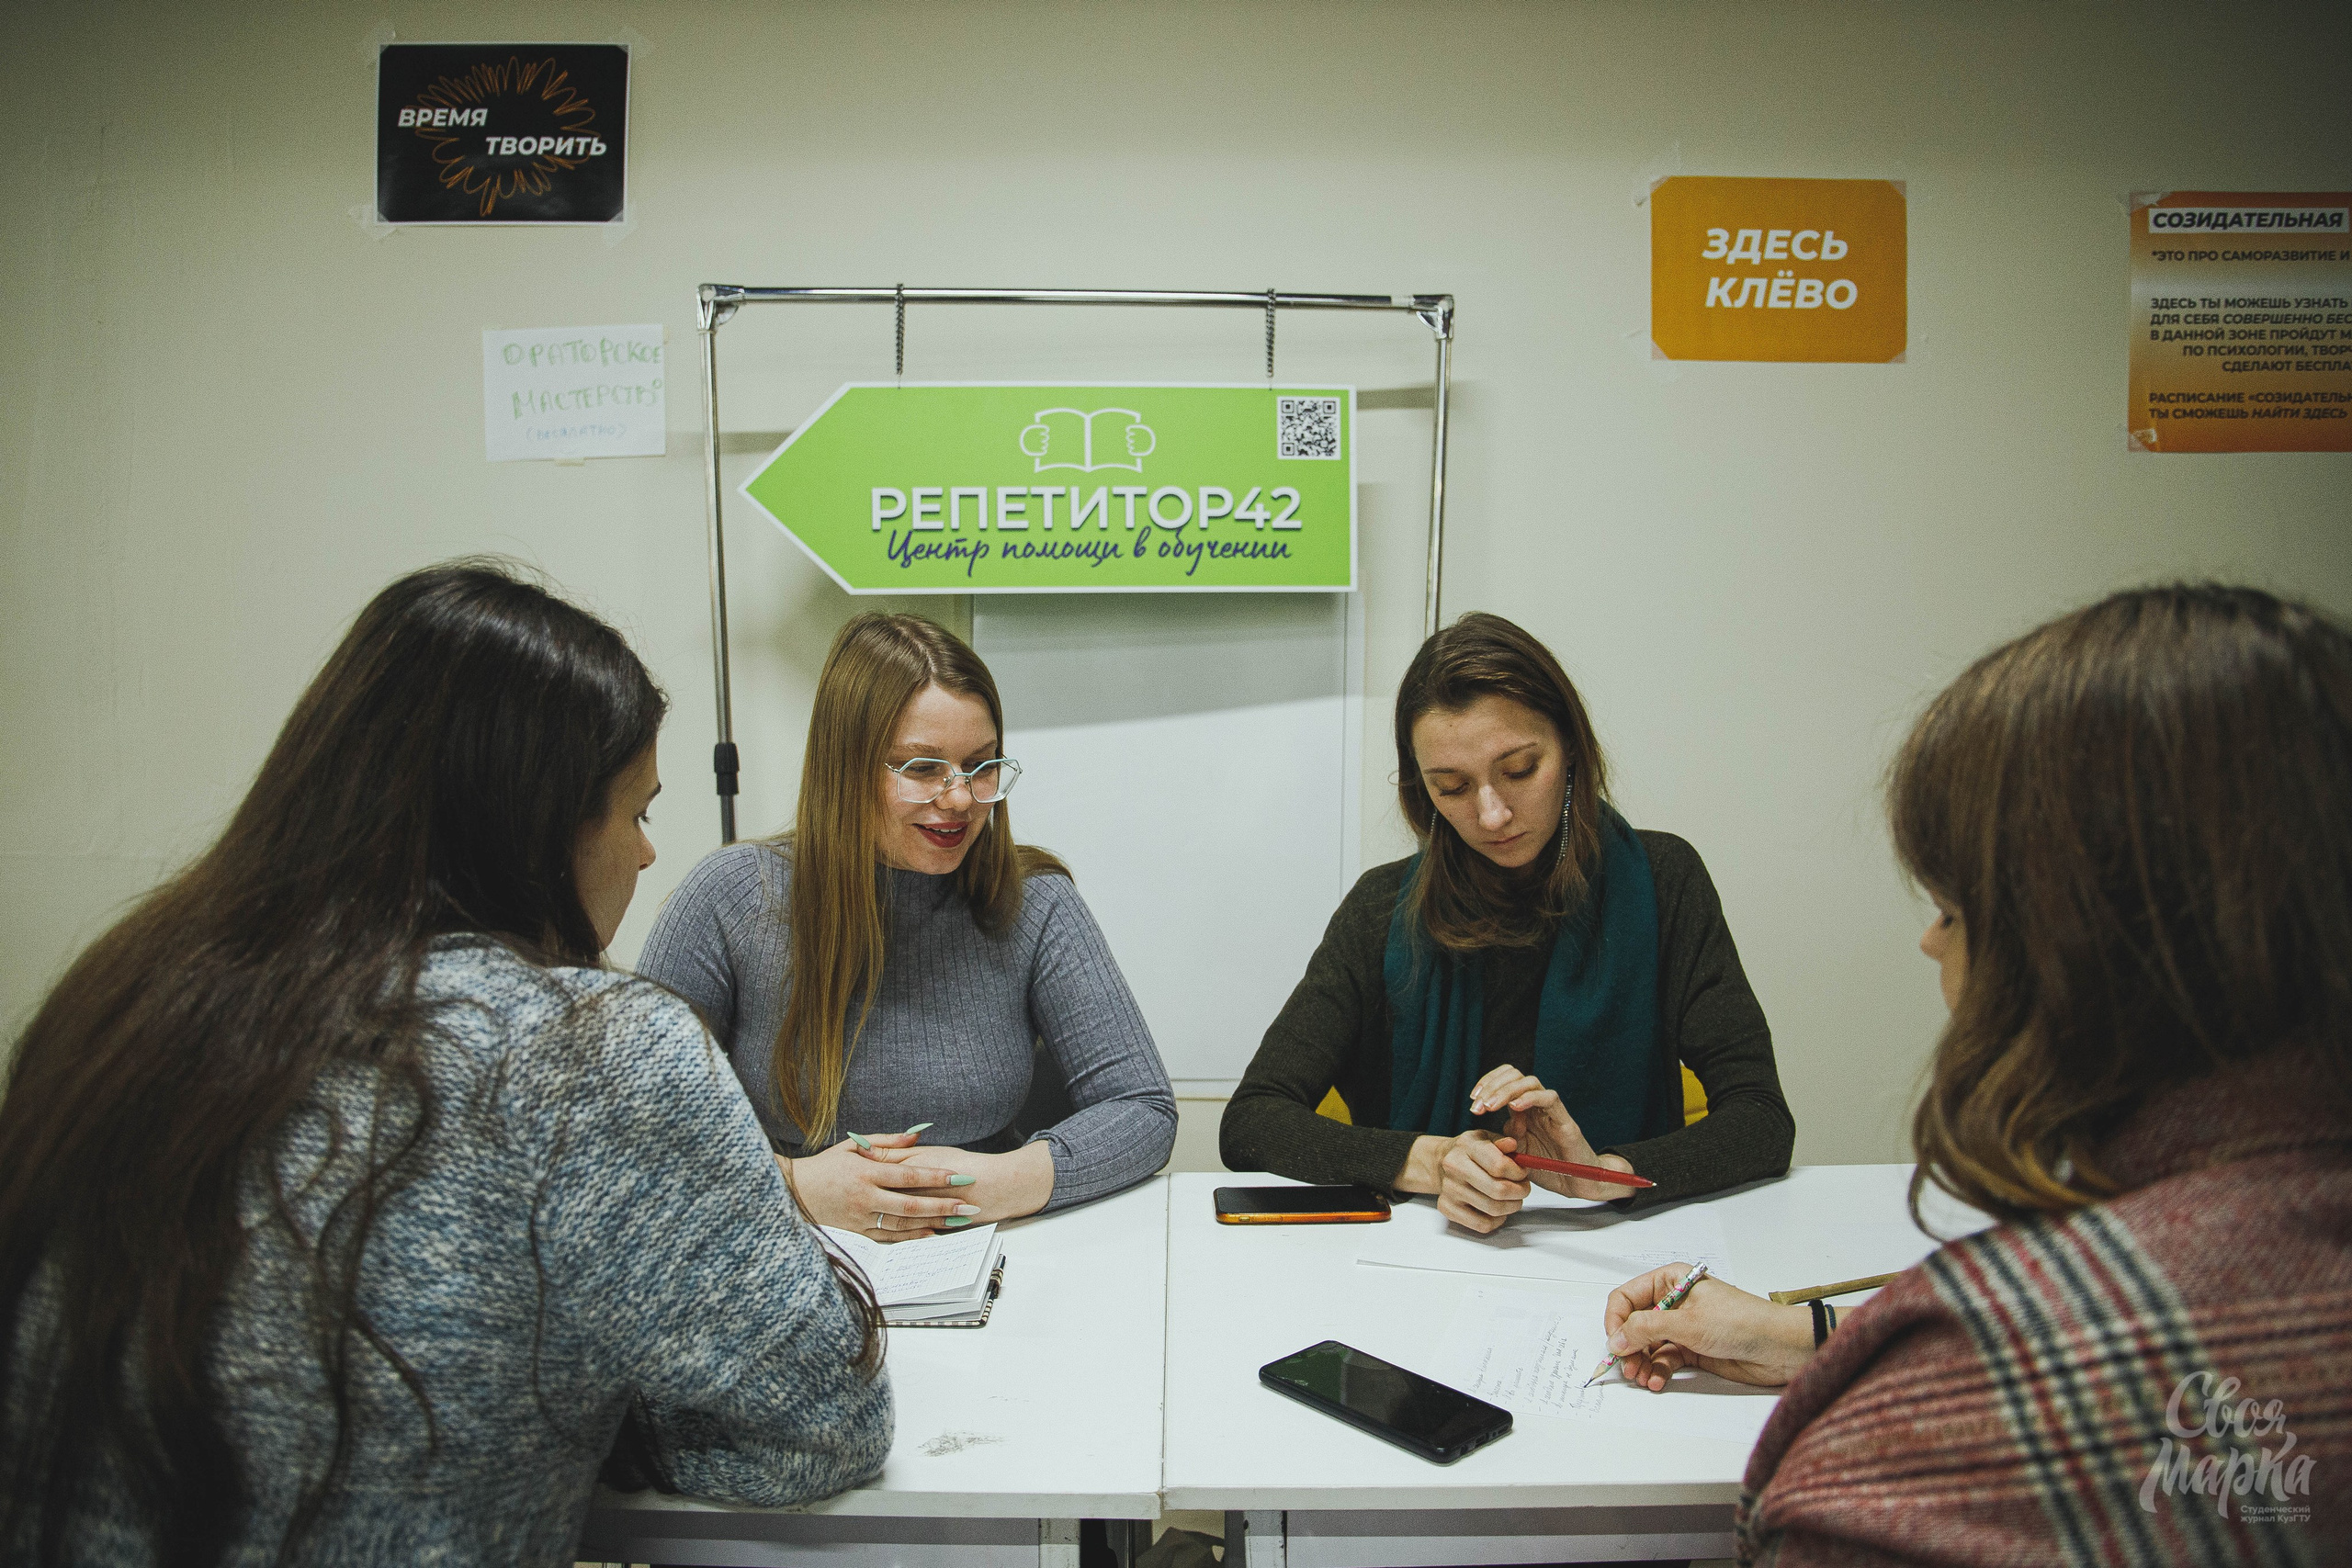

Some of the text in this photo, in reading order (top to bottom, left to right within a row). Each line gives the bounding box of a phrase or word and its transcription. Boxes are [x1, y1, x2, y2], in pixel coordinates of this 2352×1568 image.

[398, 107, 489, 128] ВРЕМЯ
[485, 136, 607, 156] ТВОРИТЬ
[2153, 212, 2344, 230] СОЗИДАТЕЛЬНАЯ
[1702, 228, 1849, 265] ЗДЕСЬ
[2188, 251, 2218, 262] ПРО
[2222, 251, 2336, 262] САМОРАЗВИТИЕ
[2340, 251, 2350, 261] И
[1705, 270, 1858, 310] КЛЁВО
[2151, 298, 2348, 310] ЗДЕСЬ ТЫ МОЖЕШЬ УЗНАТЬ
[2150, 314, 2181, 325] ДЛЯ
[2185, 314, 2220, 324] СЕБЯ
[2223, 313, 2324, 324] СОВЕРШЕННО
[2151, 330, 2159, 341] В
[2162, 327, 2224, 342] ДАННОЙ
[2228, 330, 2267, 341] ЗОНЕ
[2270, 327, 2336, 341] ПРОЙДУТ
[502, 336, 662, 367] ОРАТОРСКОЕ
[2183, 345, 2204, 356] ПО
[2208, 345, 2308, 357] ПСИХОЛОГИИ,
[2222, 361, 2291, 372] СДЕЛАЮТ
[2150, 392, 2245, 403] РАСПИСАНИЕ
[2150, 406, 2347, 419] ТЫ СМОЖЕШЬ НАЙТИ ЗДЕСЬ
[871, 486, 1303, 532] РЕПЕТИТОР42
[888, 526, 1294, 578] Центр помощи в обучении
